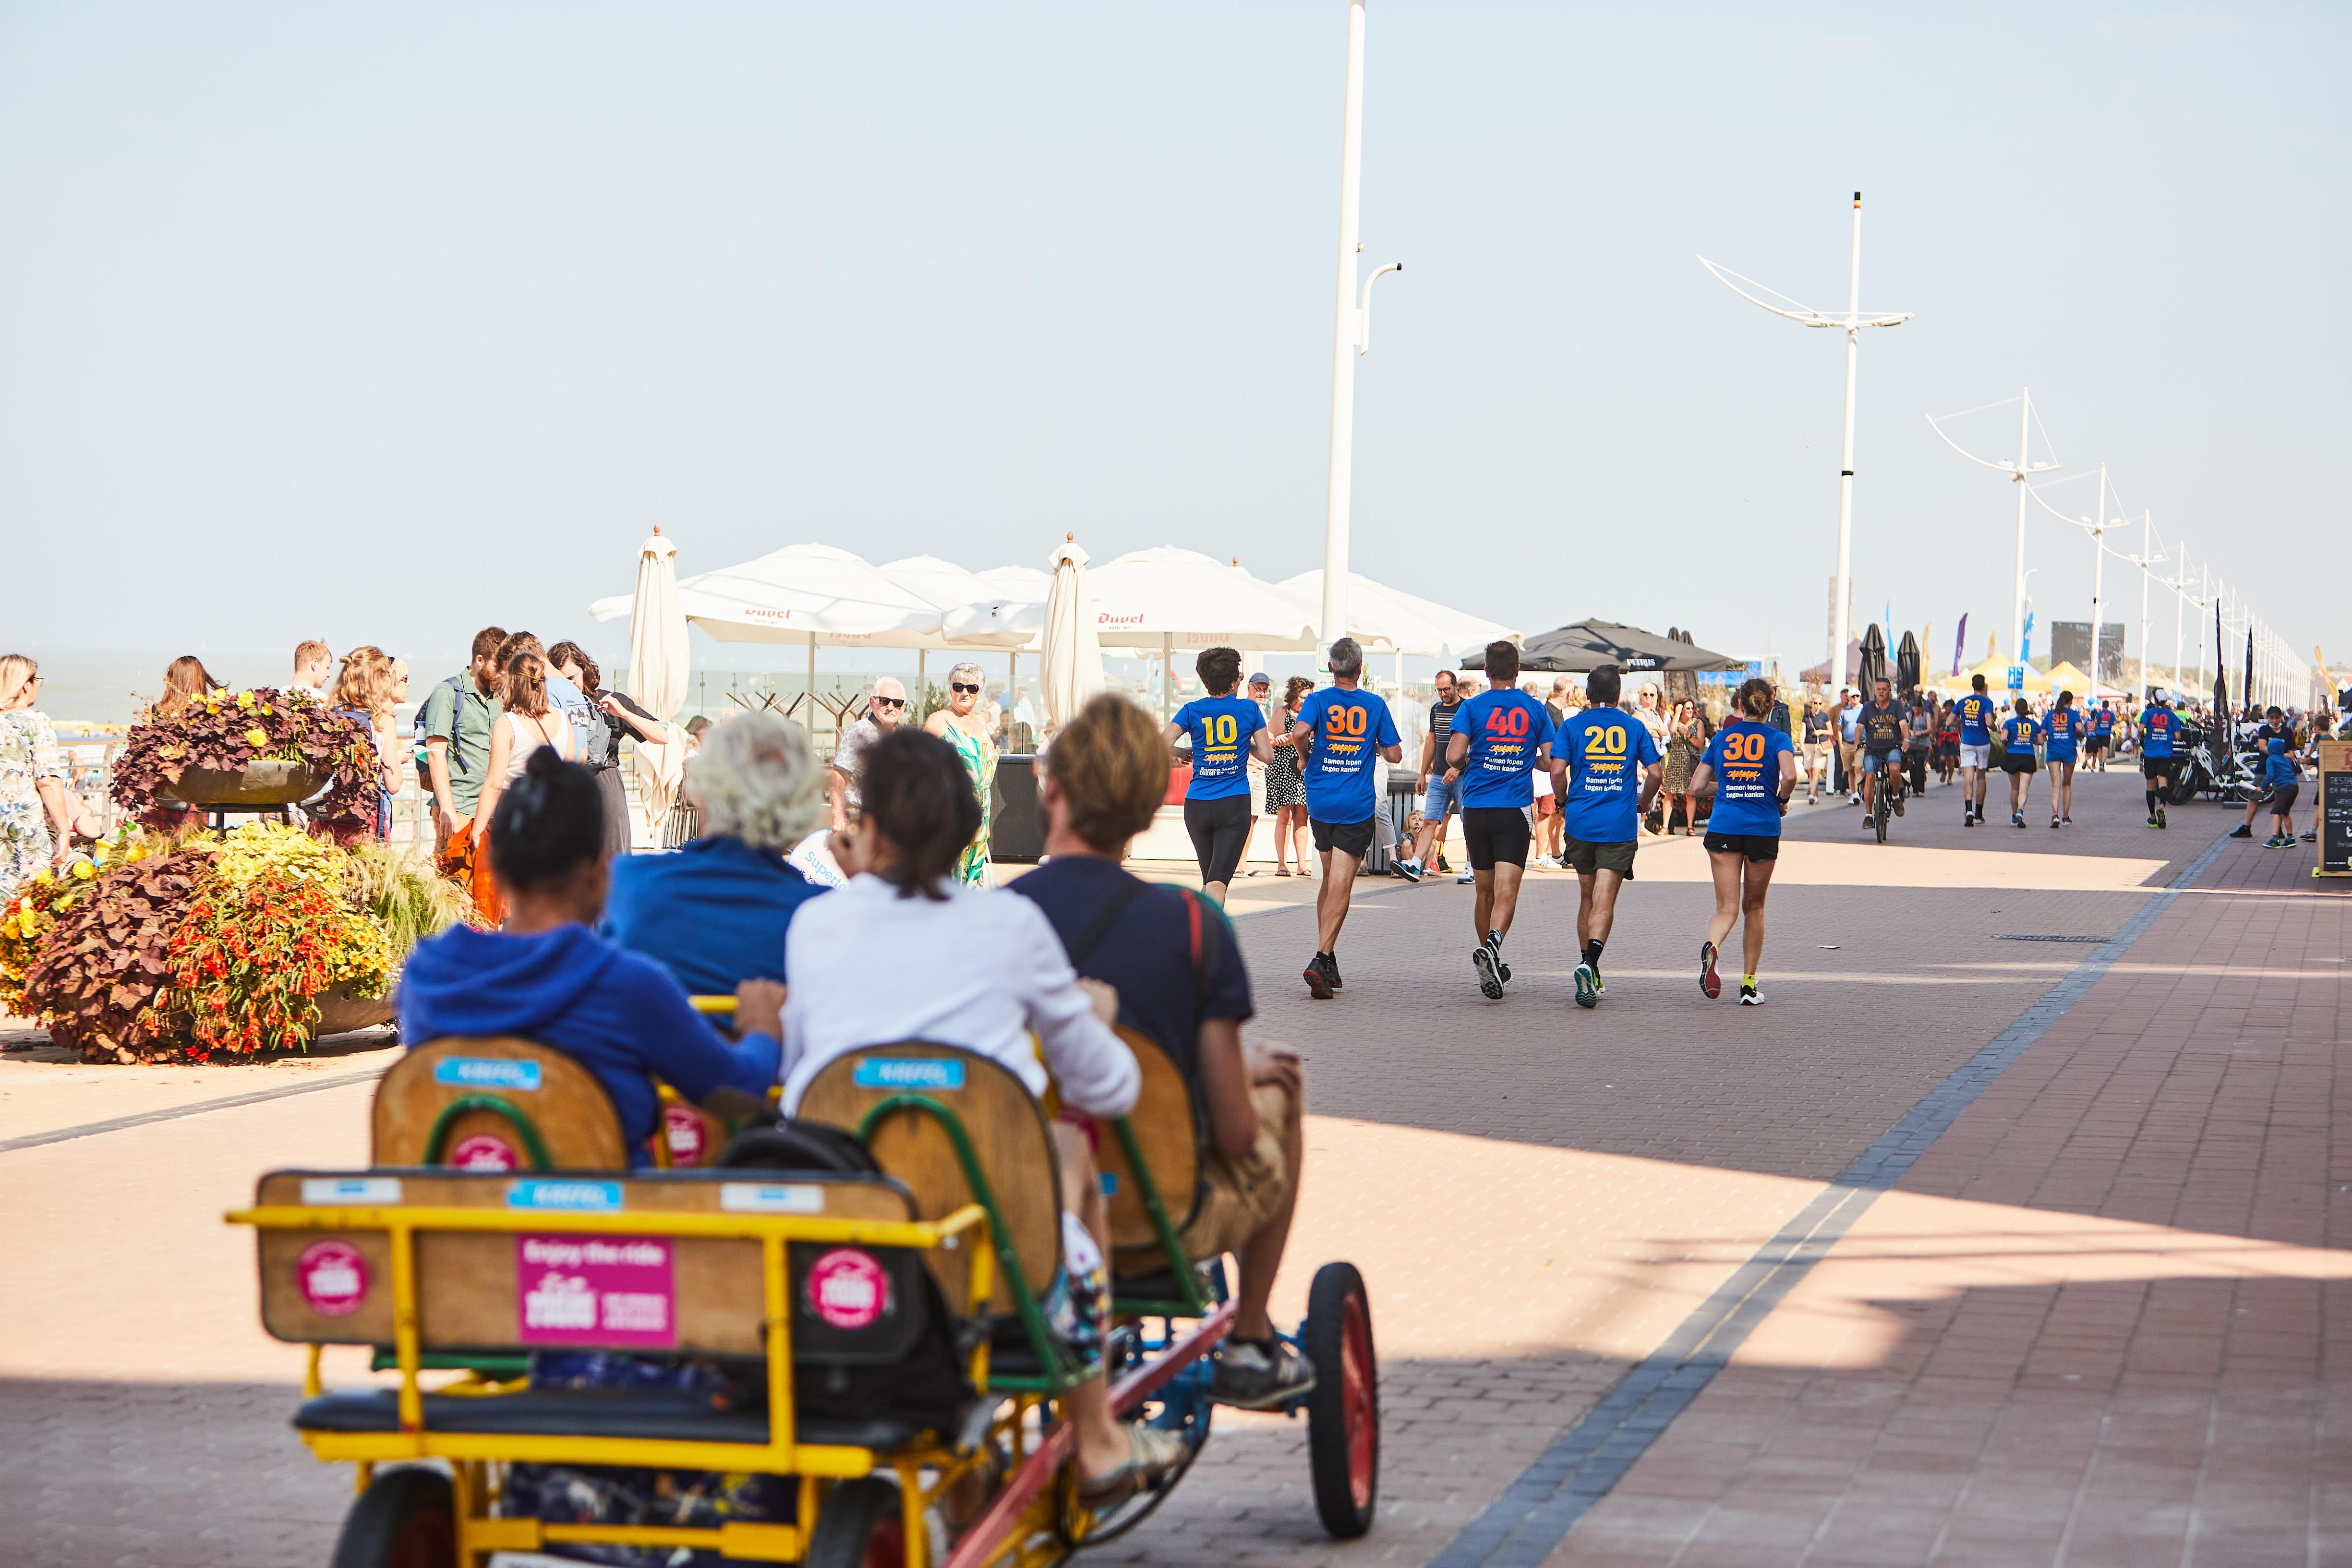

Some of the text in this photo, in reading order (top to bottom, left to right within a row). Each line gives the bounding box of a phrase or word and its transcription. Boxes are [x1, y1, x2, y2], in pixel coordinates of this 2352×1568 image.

[1098, 613, 1144, 623] Duvel
[1626, 658, 1656, 668] PETRUS
[1964, 699, 1980, 712] 20
[1326, 705, 1367, 735] 30
[1485, 707, 1529, 736] 40
[2051, 712, 2068, 724] 30
[2151, 712, 2168, 725] 40
[1201, 714, 1237, 745] 10
[2016, 722, 2032, 735] 10
[1584, 725, 1626, 754] 20
[1723, 733, 1765, 761] 30
[1483, 762, 1501, 771] tegen
